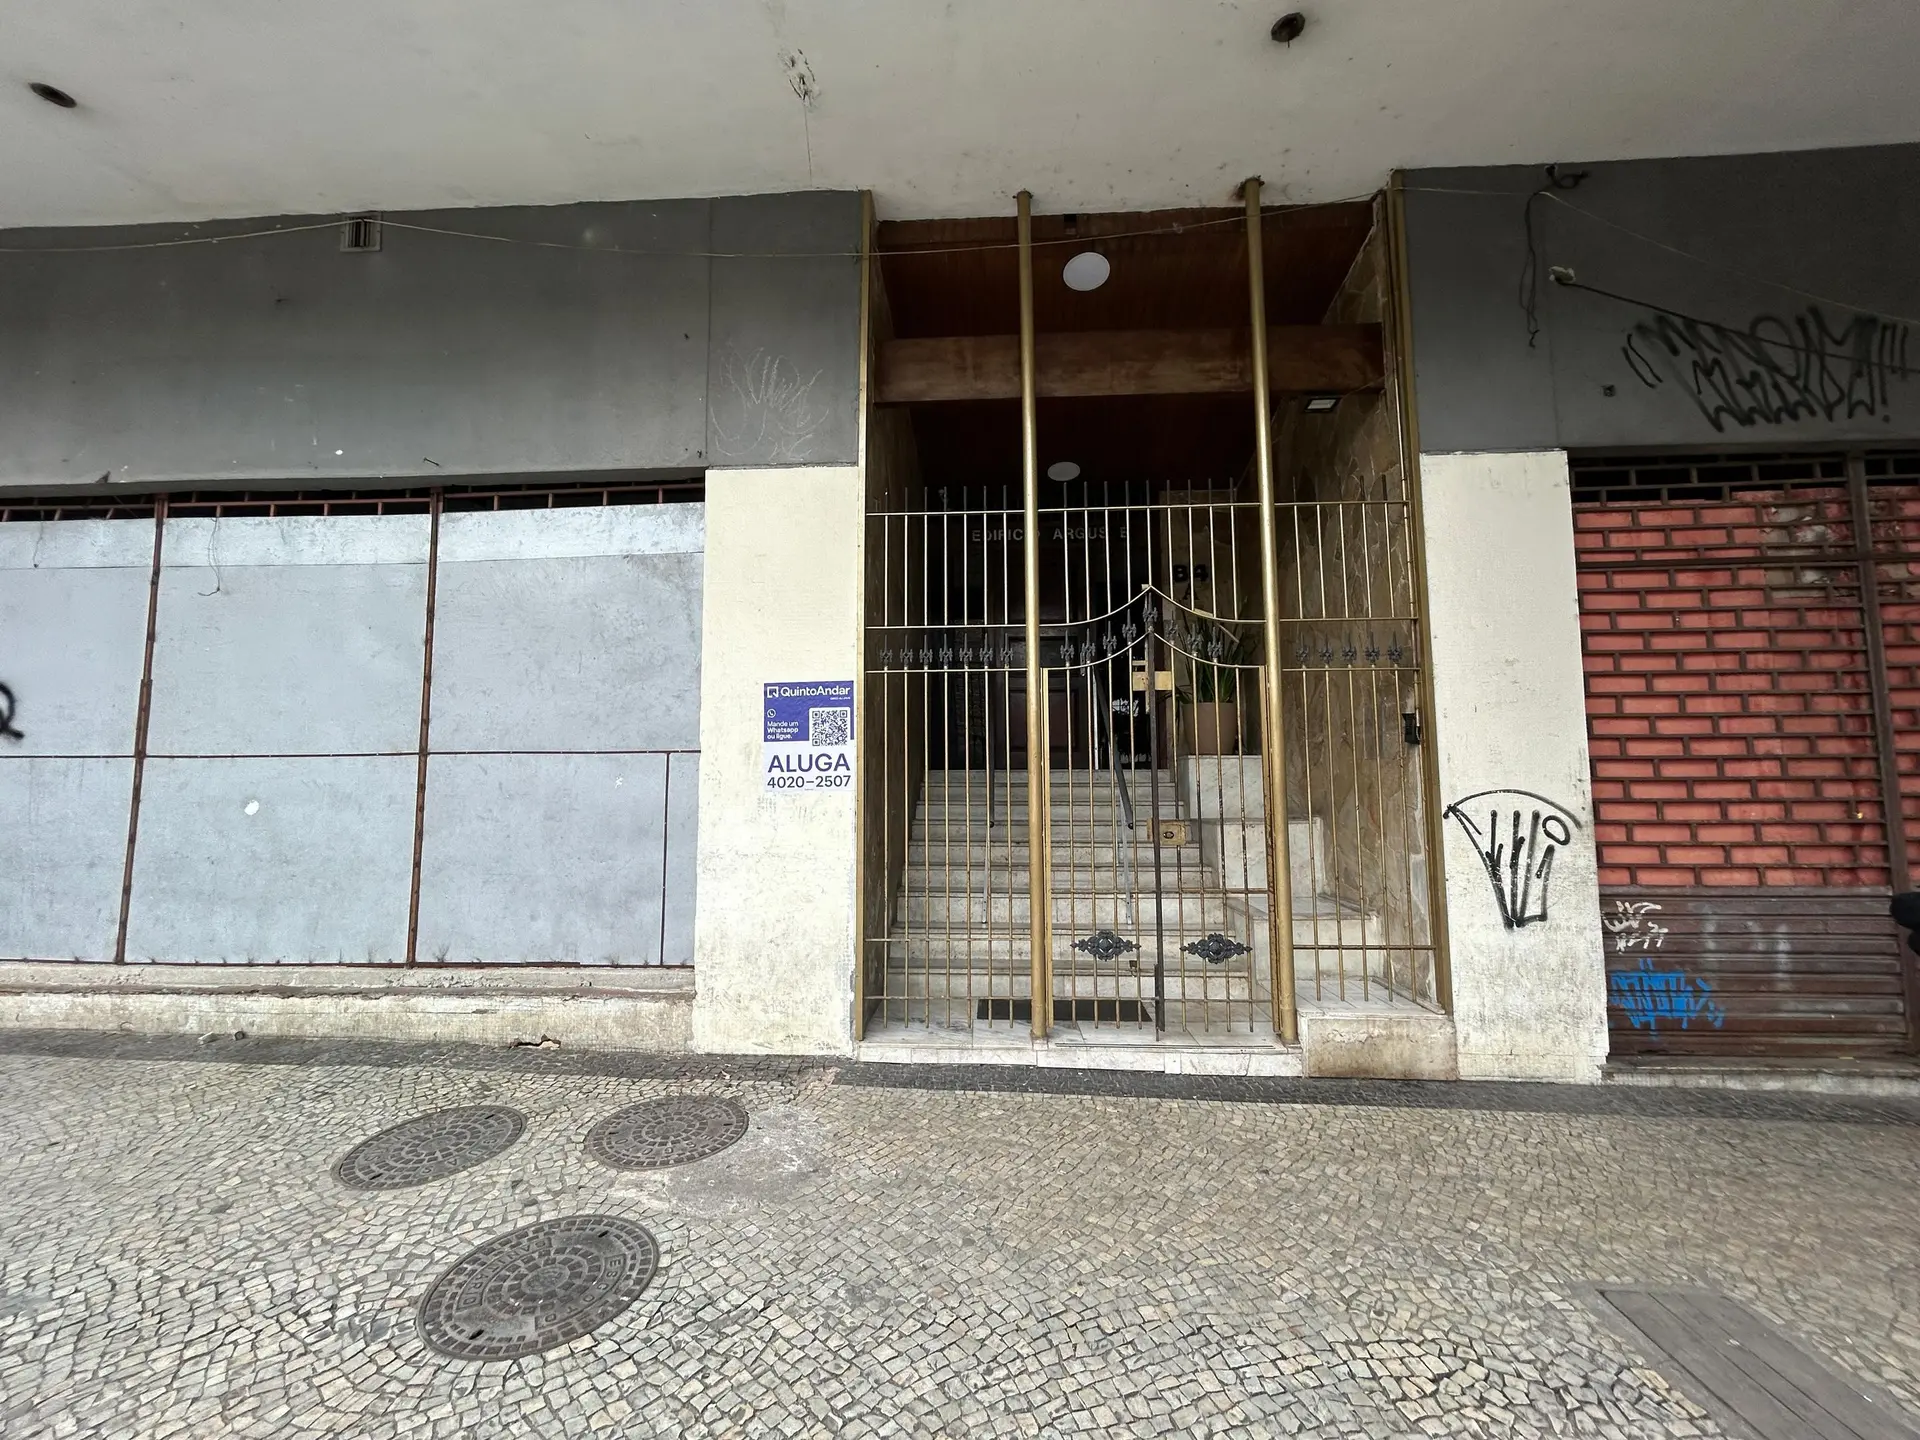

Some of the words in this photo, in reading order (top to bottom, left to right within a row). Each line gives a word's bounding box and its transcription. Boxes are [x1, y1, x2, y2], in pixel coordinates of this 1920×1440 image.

[971, 527, 1041, 542] EDIFIC
[1052, 526, 1108, 540] ARGUS
[780, 685, 851, 698] QuintoAndar
[767, 727, 799, 735] Whatsapp
[776, 733, 793, 741] ligue.
[768, 753, 851, 773] ALUGA
[767, 775, 851, 789] 4020-2507
[545, 1254, 623, 1323] ESGOTO
